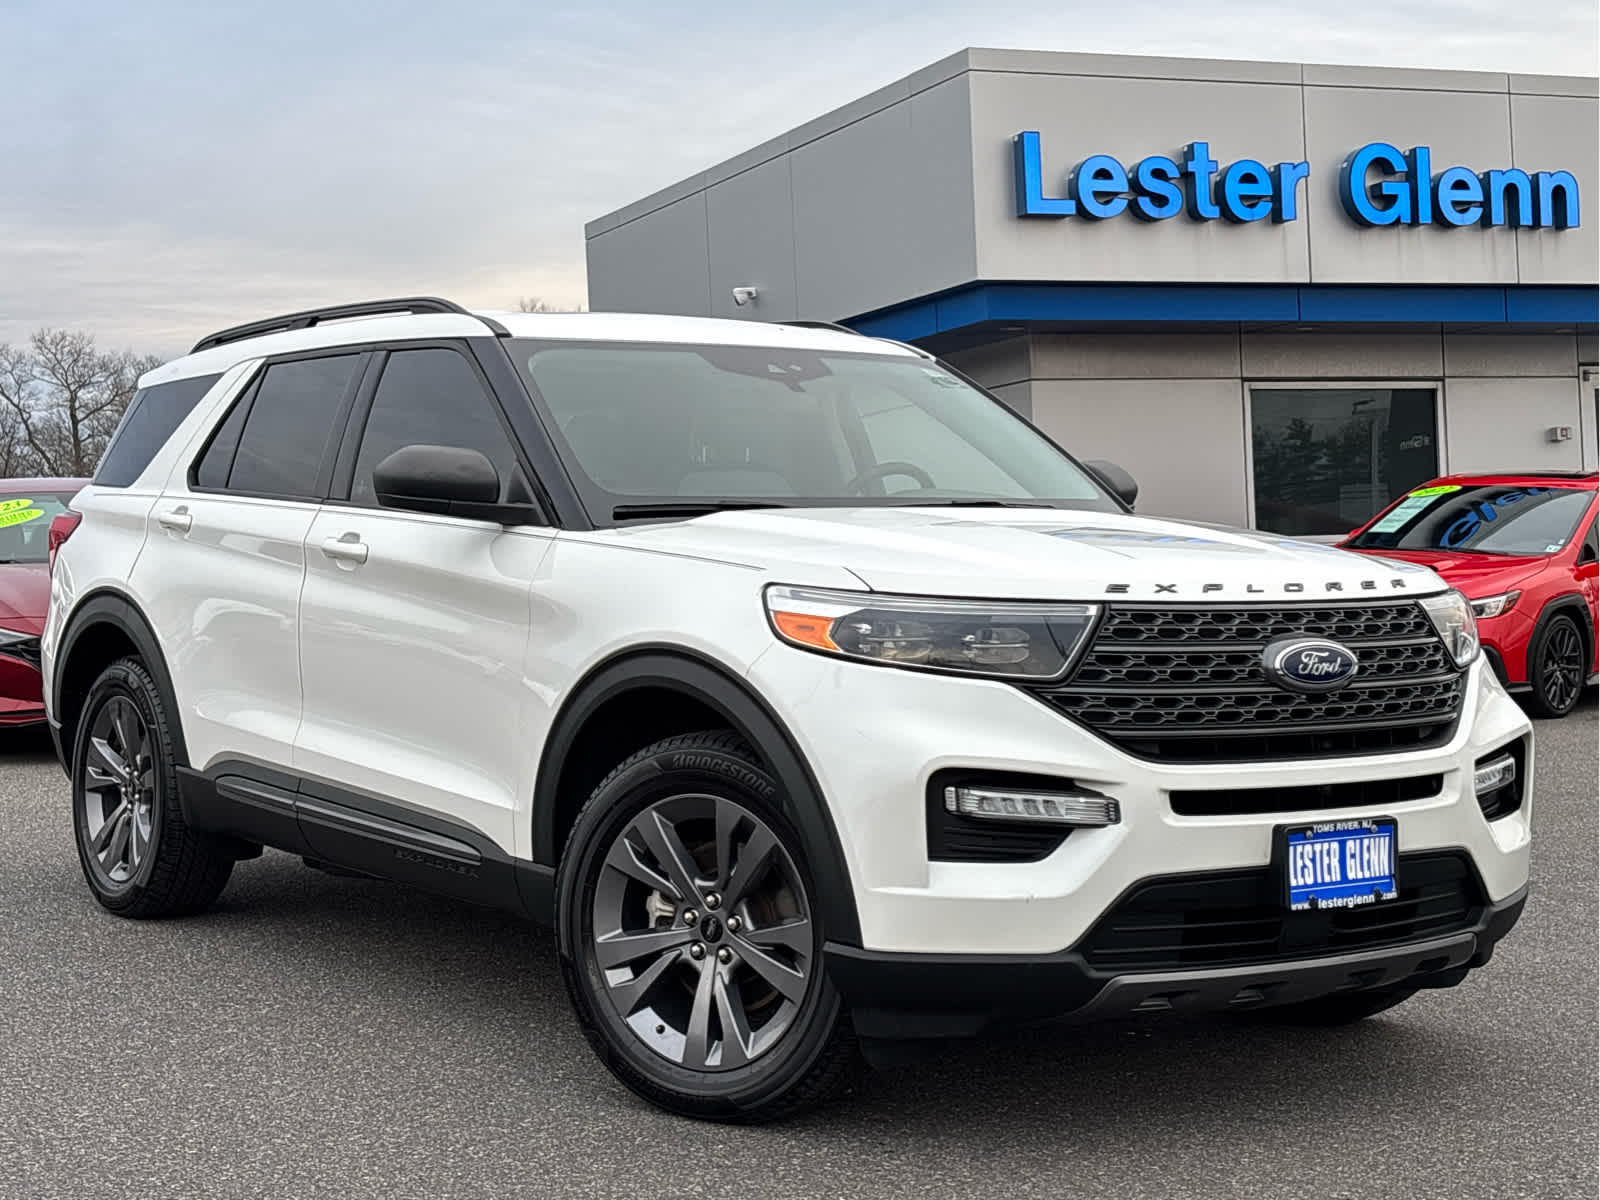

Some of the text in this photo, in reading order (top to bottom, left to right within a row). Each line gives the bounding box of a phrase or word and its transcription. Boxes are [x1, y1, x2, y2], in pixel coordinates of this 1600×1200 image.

[1015, 130, 1581, 228] Lester Glenn
[1104, 579, 1406, 594] EXPLORER
[1298, 651, 1343, 676] Ford
[1312, 823, 1335, 833] TOMS
[1362, 818, 1373, 829] NJ
[1289, 837, 1390, 886] LESTER GLENN
